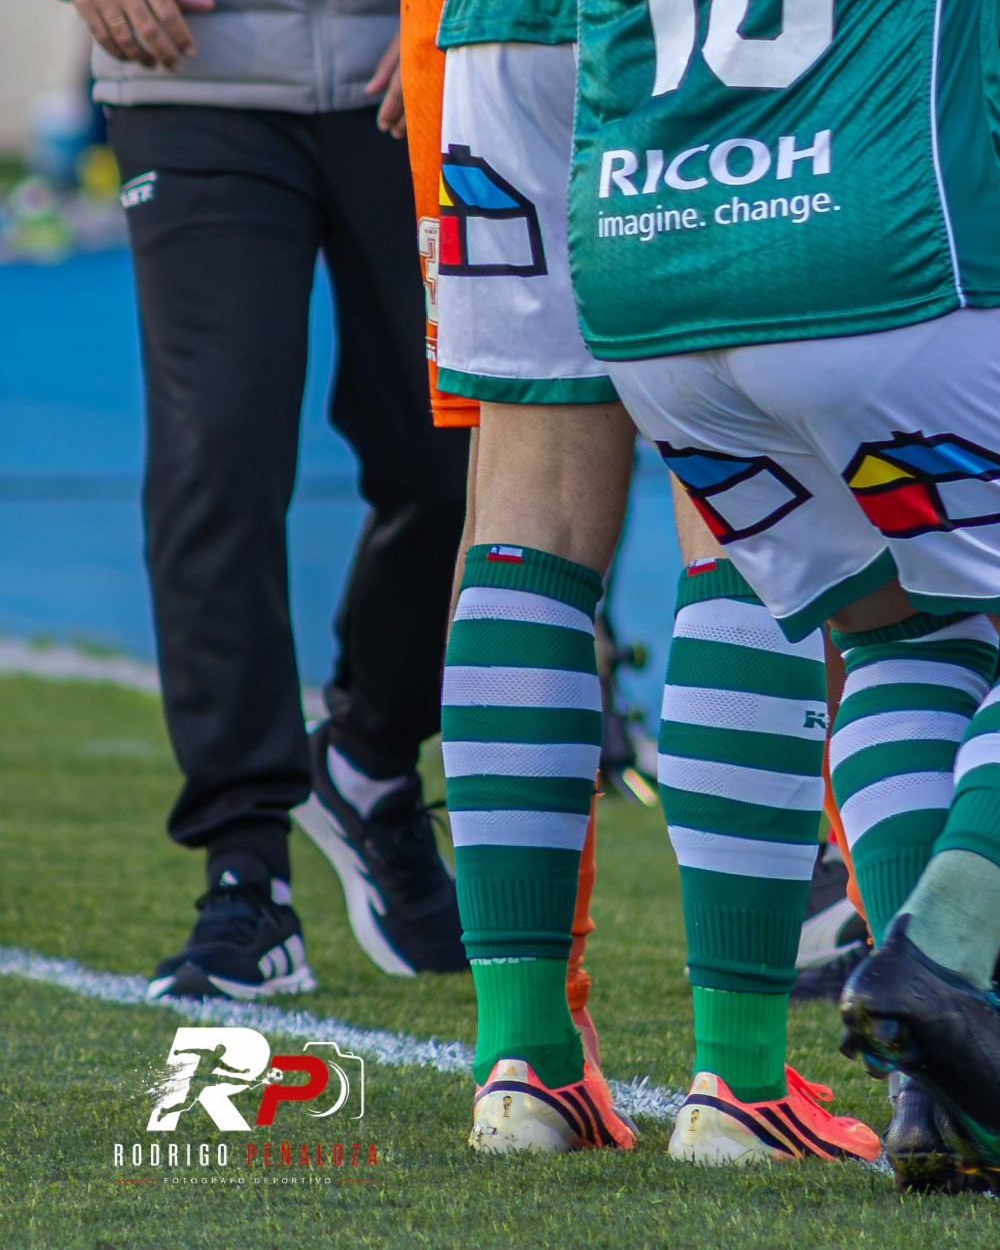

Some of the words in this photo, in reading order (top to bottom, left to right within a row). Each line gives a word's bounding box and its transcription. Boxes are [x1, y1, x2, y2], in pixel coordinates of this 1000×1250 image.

[598, 129, 831, 199] RICOH
[598, 204, 707, 242] imagine.
[714, 192, 841, 224] change.
